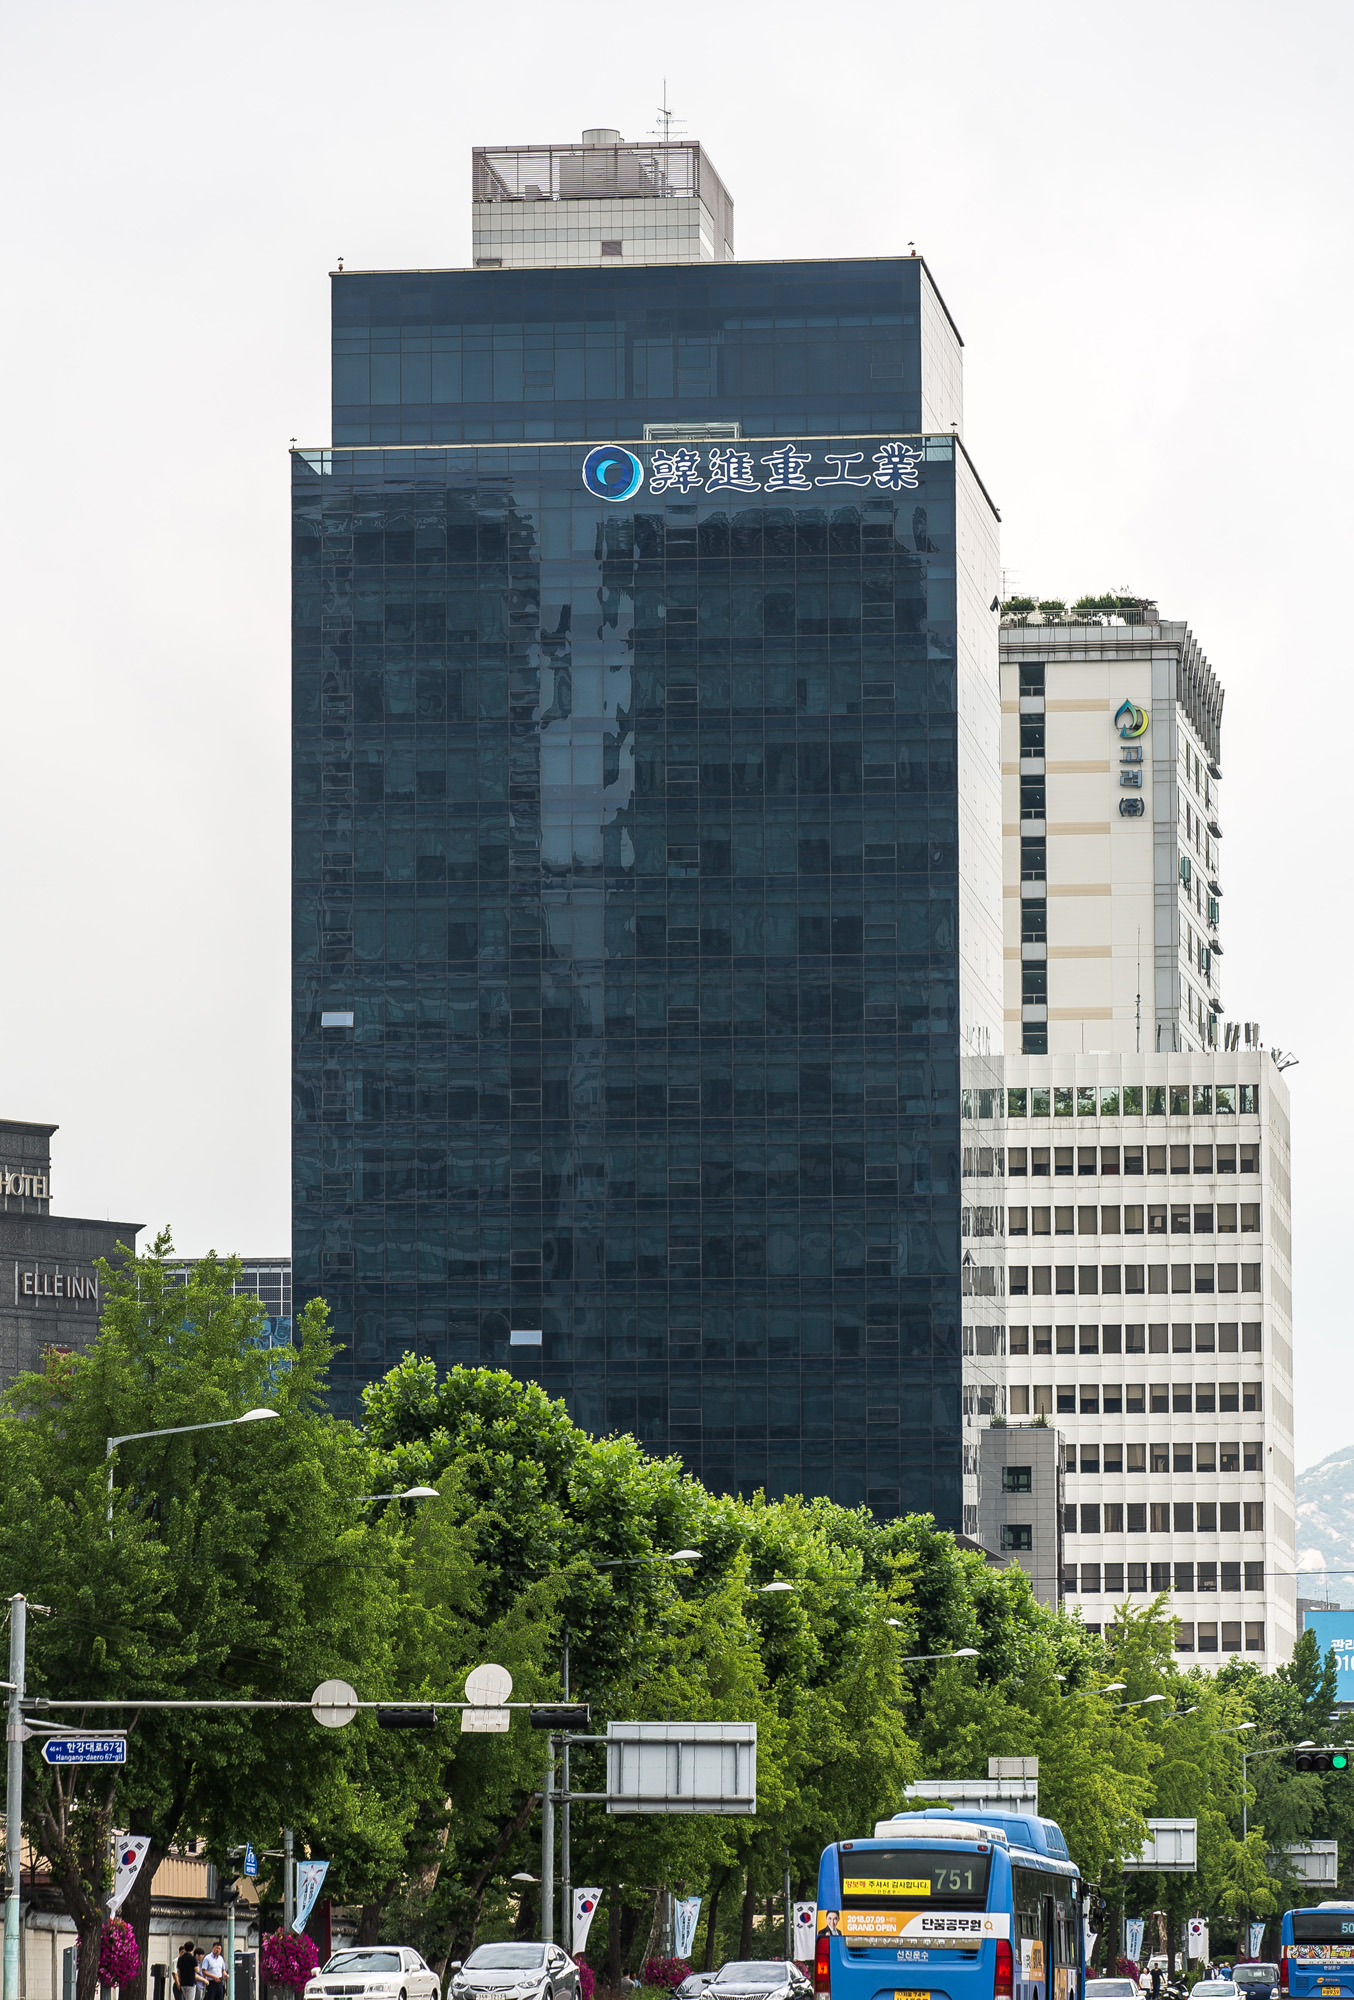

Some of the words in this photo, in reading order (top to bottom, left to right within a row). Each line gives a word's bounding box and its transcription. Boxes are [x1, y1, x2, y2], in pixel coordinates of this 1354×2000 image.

[649, 442, 923, 495] 韓進重工業
[0, 1171, 53, 1199] HOTEL
[22, 1272, 63, 1297] ELLE
[66, 1275, 98, 1299] INN
[66, 1742, 123, 1753] 한강대로67길
[55, 1753, 104, 1762] Hangang-daero
[104, 1753, 123, 1762] 67-gil
[934, 1868, 973, 1891] 751
[847, 1915, 886, 1924] 2018.07.09
[921, 1918, 982, 1932] 단꿈공무원
[847, 1923, 875, 1931] GRAND
[875, 1924, 897, 1932] OPEN
